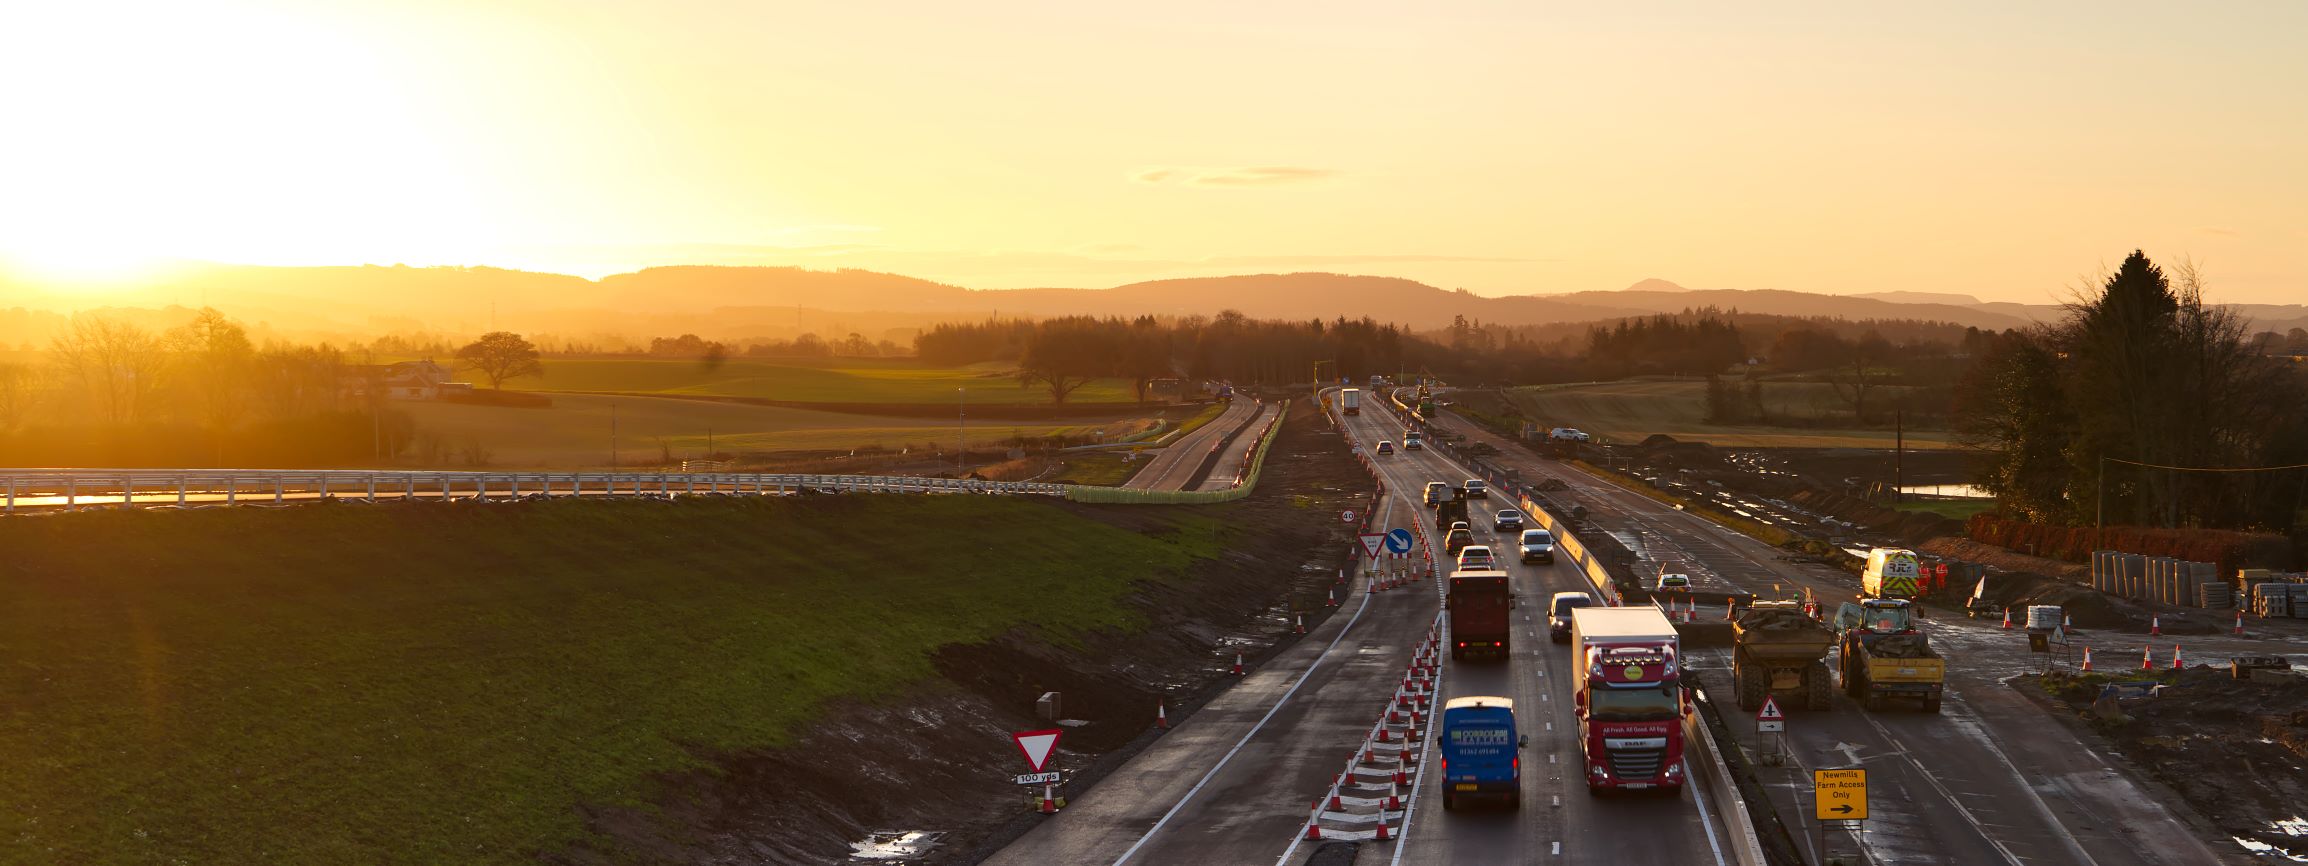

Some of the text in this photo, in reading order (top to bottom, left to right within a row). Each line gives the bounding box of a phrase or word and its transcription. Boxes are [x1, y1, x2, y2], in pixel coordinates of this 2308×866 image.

[1021, 774, 1038, 782] 100
[1817, 781, 1836, 789] Farm
[1832, 791, 1850, 799] Only
